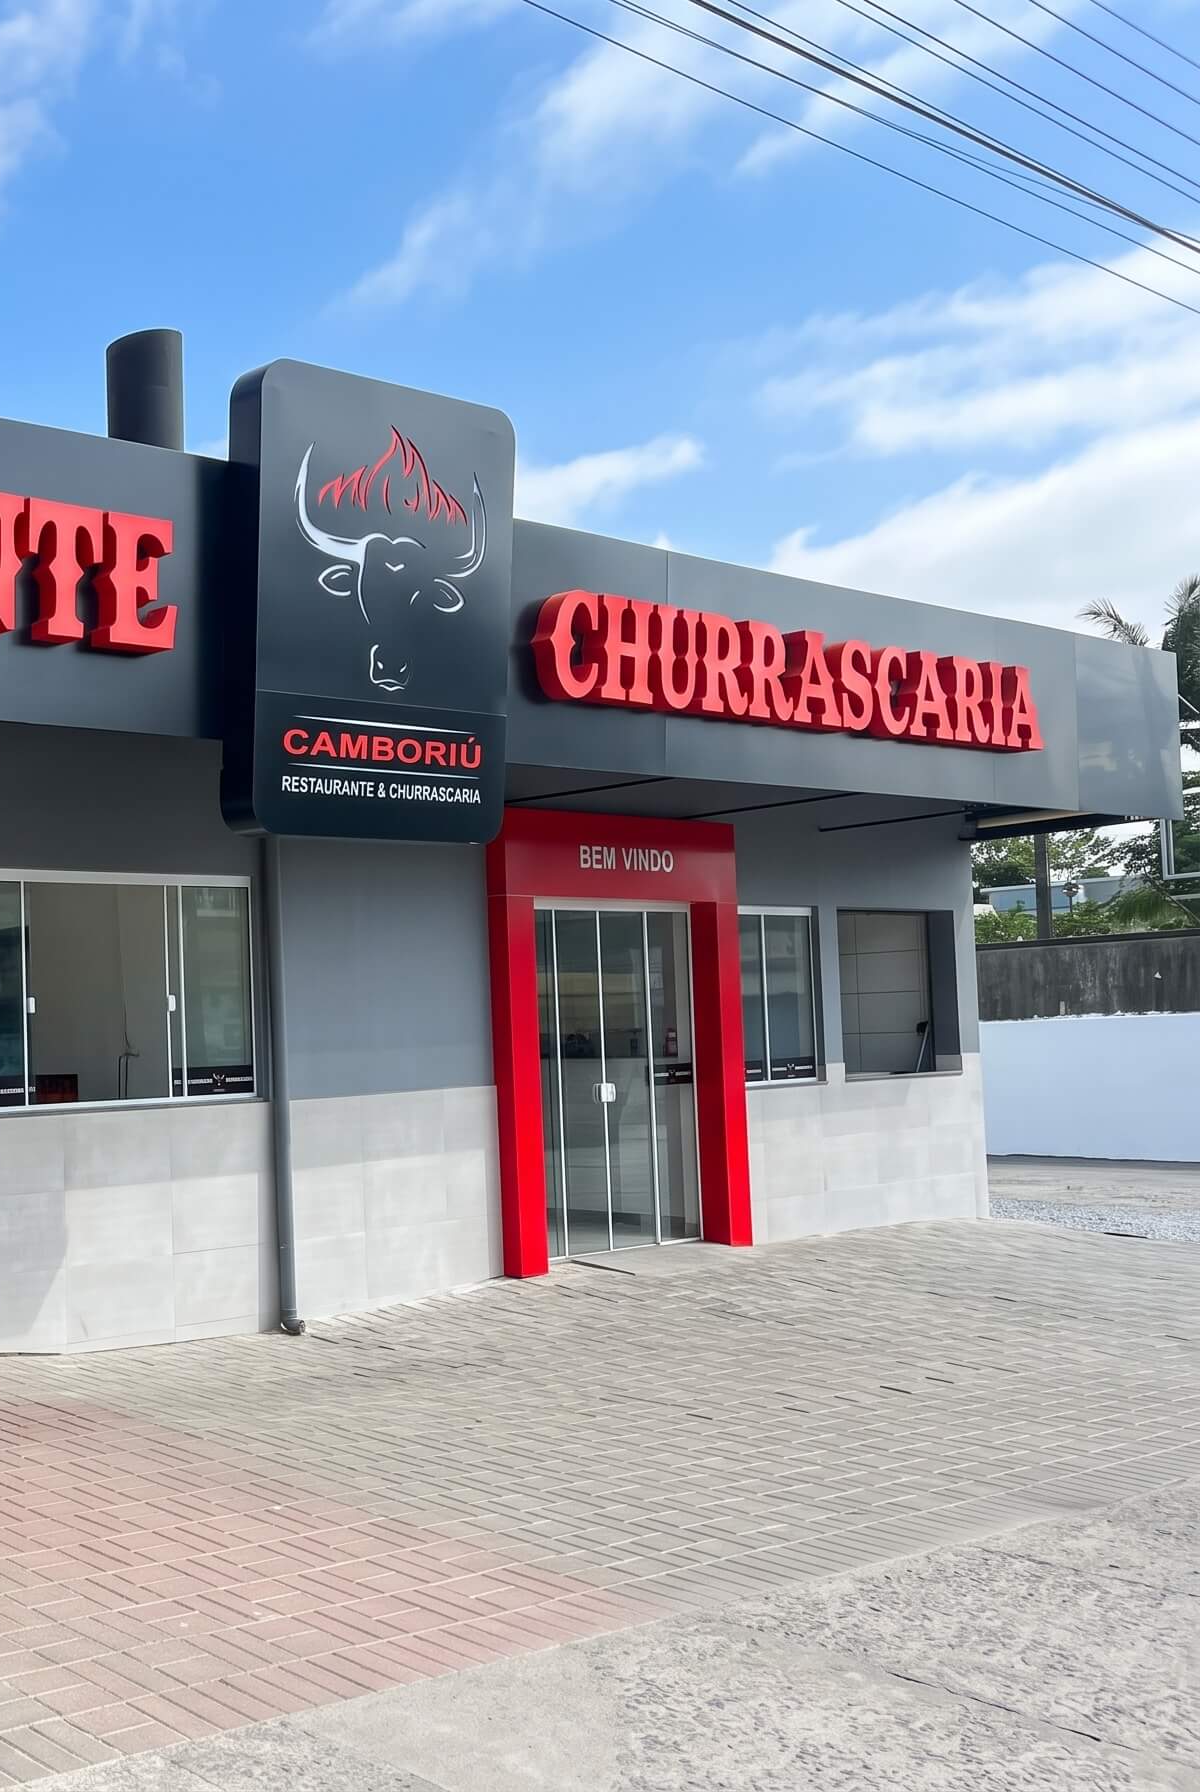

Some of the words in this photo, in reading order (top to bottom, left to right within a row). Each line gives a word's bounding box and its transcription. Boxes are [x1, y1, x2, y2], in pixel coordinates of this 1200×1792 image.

[530, 589, 1045, 752] CHURRASCARIA
[283, 728, 481, 769] CAMBORIÚ
[281, 775, 375, 798] RESTAURANTE
[377, 782, 386, 798] &
[389, 783, 481, 804] CHURRASCARIA
[580, 845, 616, 870] BEM
[622, 848, 673, 872] VINDO
